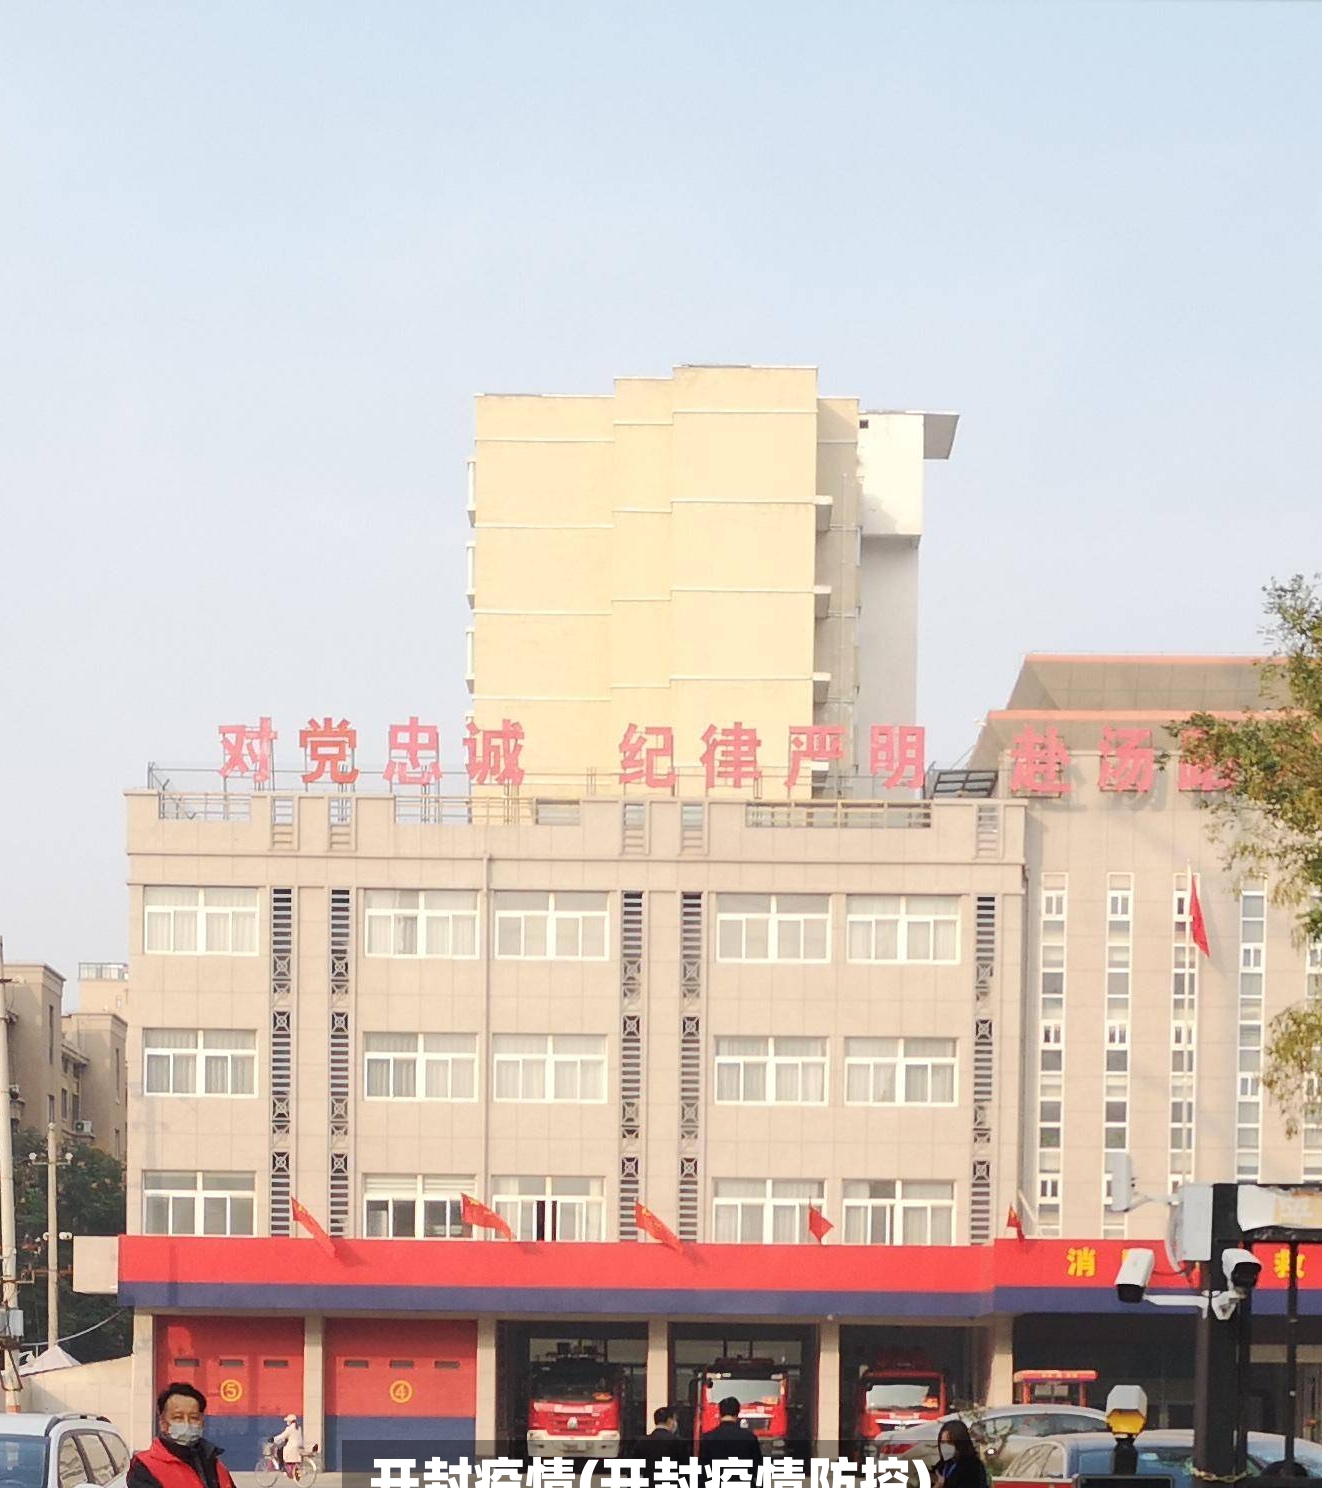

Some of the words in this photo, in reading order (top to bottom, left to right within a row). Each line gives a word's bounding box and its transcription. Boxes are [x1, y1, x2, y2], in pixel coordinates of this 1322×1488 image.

[218, 716, 525, 786] 对党忠诚
[619, 721, 926, 790] 纪律严明
